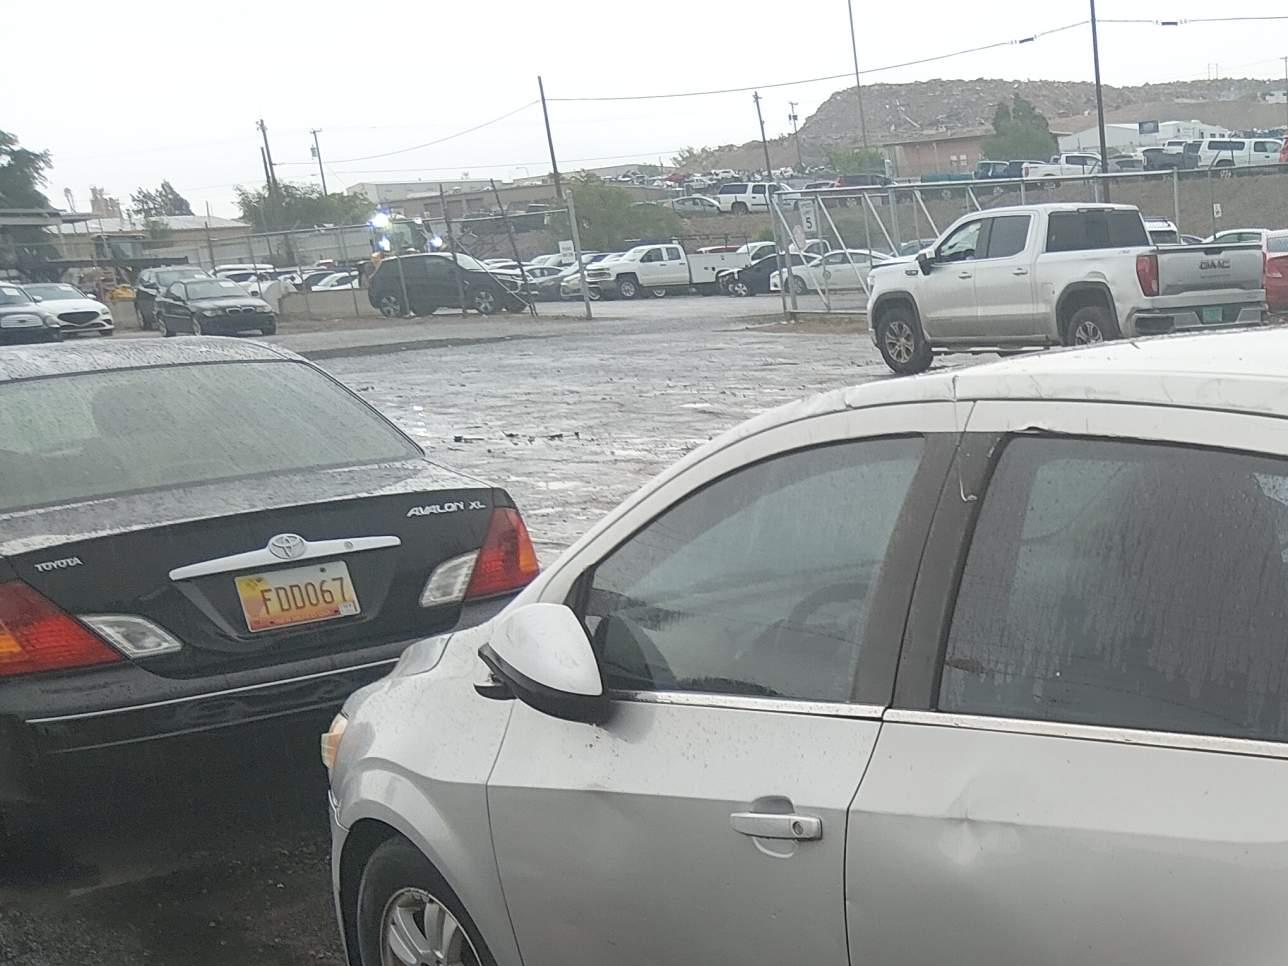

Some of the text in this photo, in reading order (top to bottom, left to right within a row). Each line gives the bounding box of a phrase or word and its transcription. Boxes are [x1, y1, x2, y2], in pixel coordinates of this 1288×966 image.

[1199, 259, 1231, 270] GMC
[406, 500, 487, 518] AVALON XL
[33, 556, 83, 572] TOYOTA
